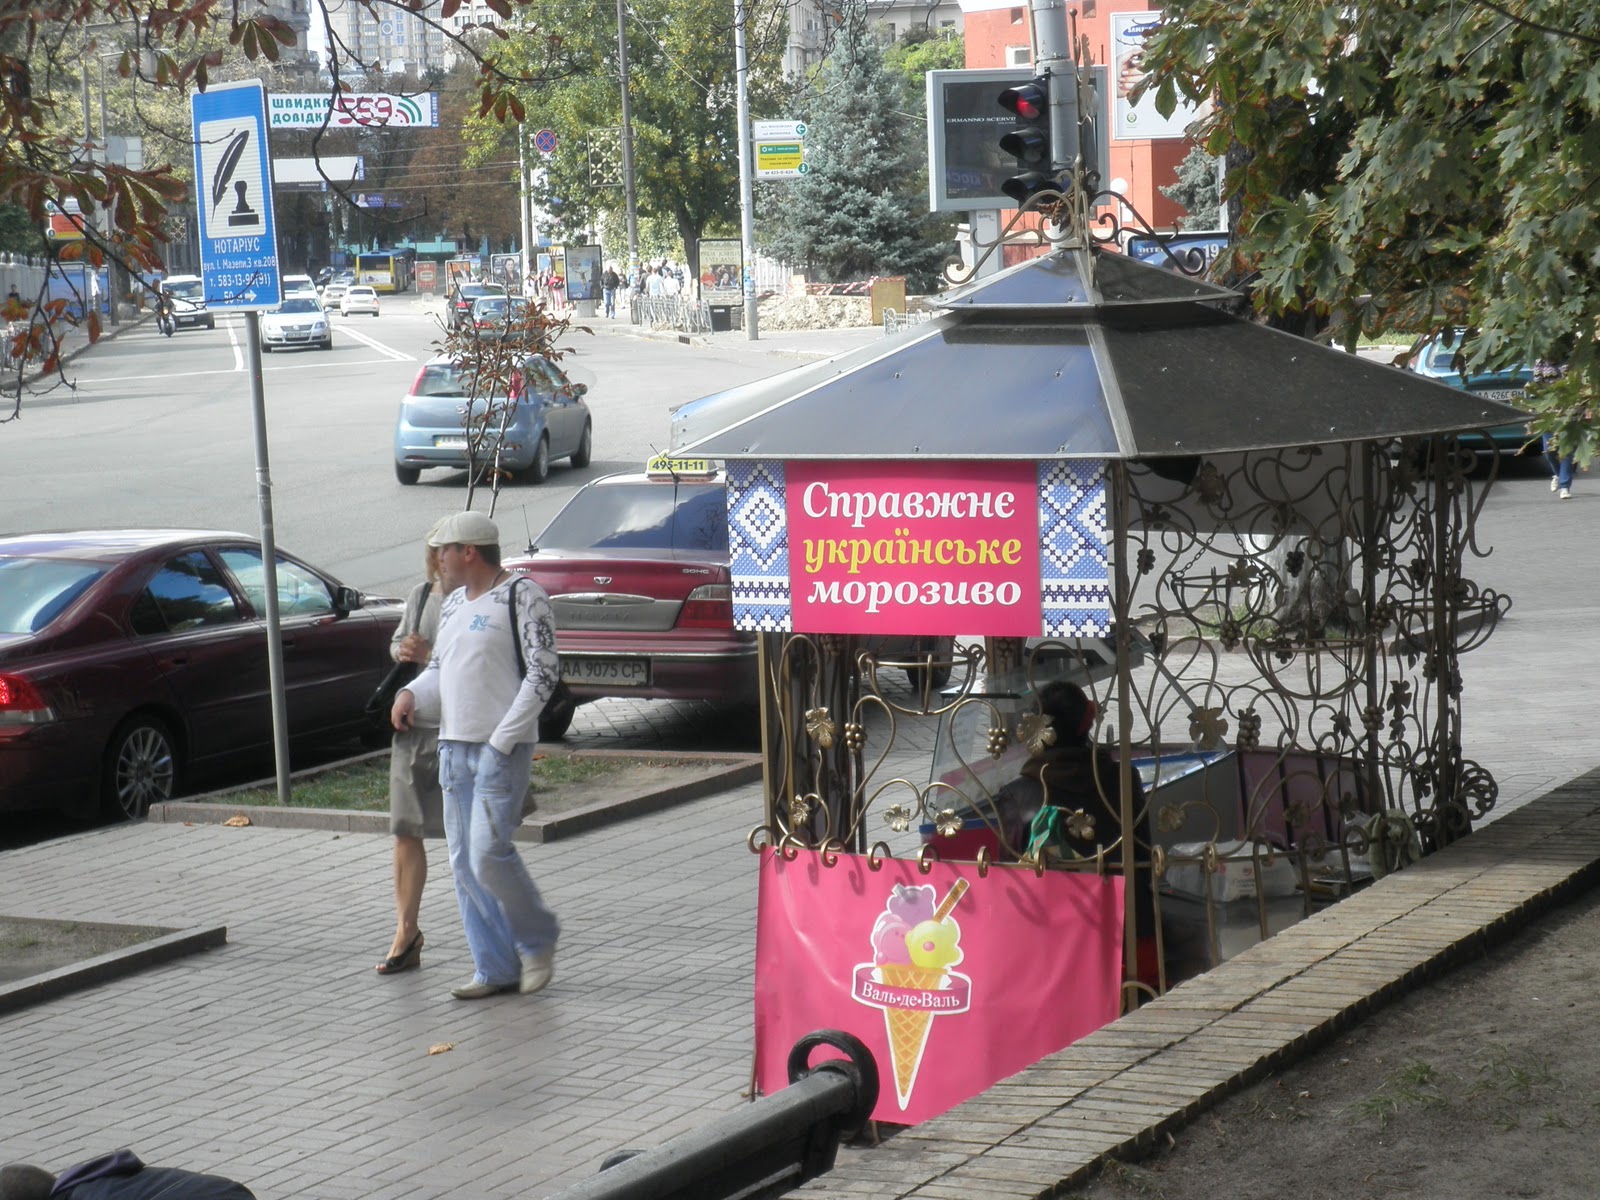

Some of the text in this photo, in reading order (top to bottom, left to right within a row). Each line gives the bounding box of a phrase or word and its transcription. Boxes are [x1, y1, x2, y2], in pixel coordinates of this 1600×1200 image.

[214, 237, 260, 254] НОТАРІУС
[223, 291, 234, 304] 50
[652, 460, 704, 470] 495-11-11
[802, 481, 1015, 528] Справжнє
[803, 527, 1022, 574] українське
[807, 580, 1022, 613] морозиво
[561, 661, 642, 679] AA 9075 CP
